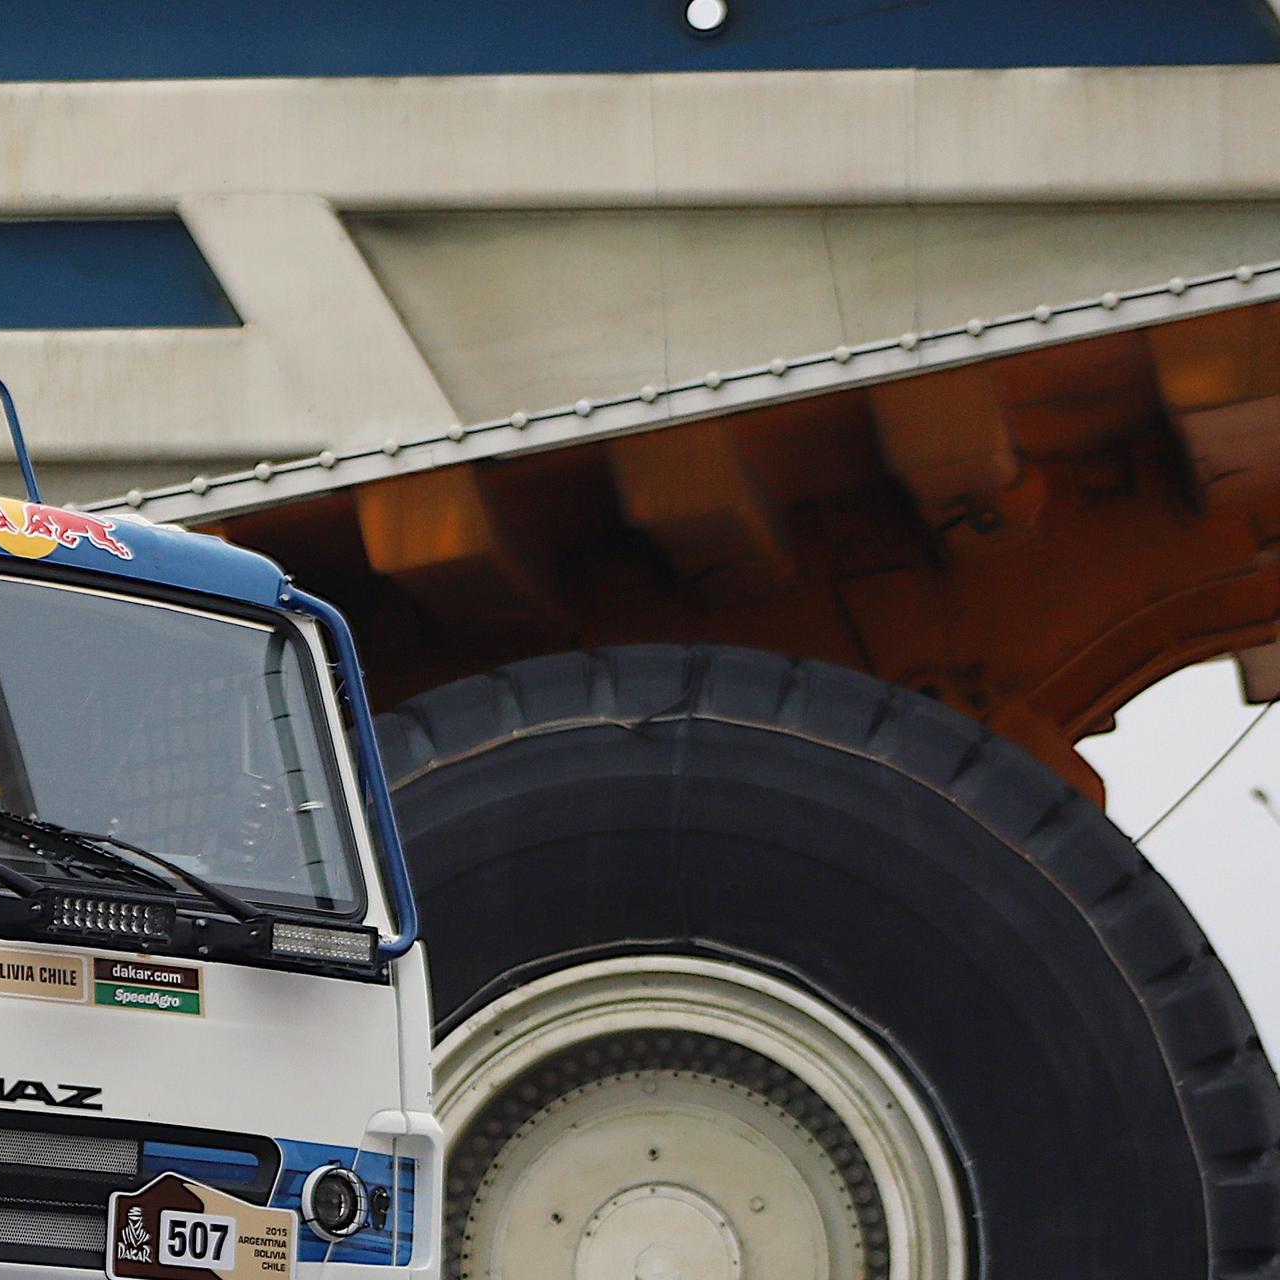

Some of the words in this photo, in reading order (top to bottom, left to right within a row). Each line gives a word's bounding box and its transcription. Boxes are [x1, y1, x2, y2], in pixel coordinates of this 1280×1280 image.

[39, 966, 78, 987] CHILE
[111, 964, 183, 985] dakar.com
[113, 988, 181, 1009] SpeedAgro
[166, 1218, 230, 1262] 507
[237, 1235, 288, 1249] ARGENTINA
[265, 1226, 288, 1237] 2015
[117, 1241, 153, 1263] DAKAR
[253, 1249, 287, 1260] BOLIVIA
[261, 1262, 286, 1272] CHILE
